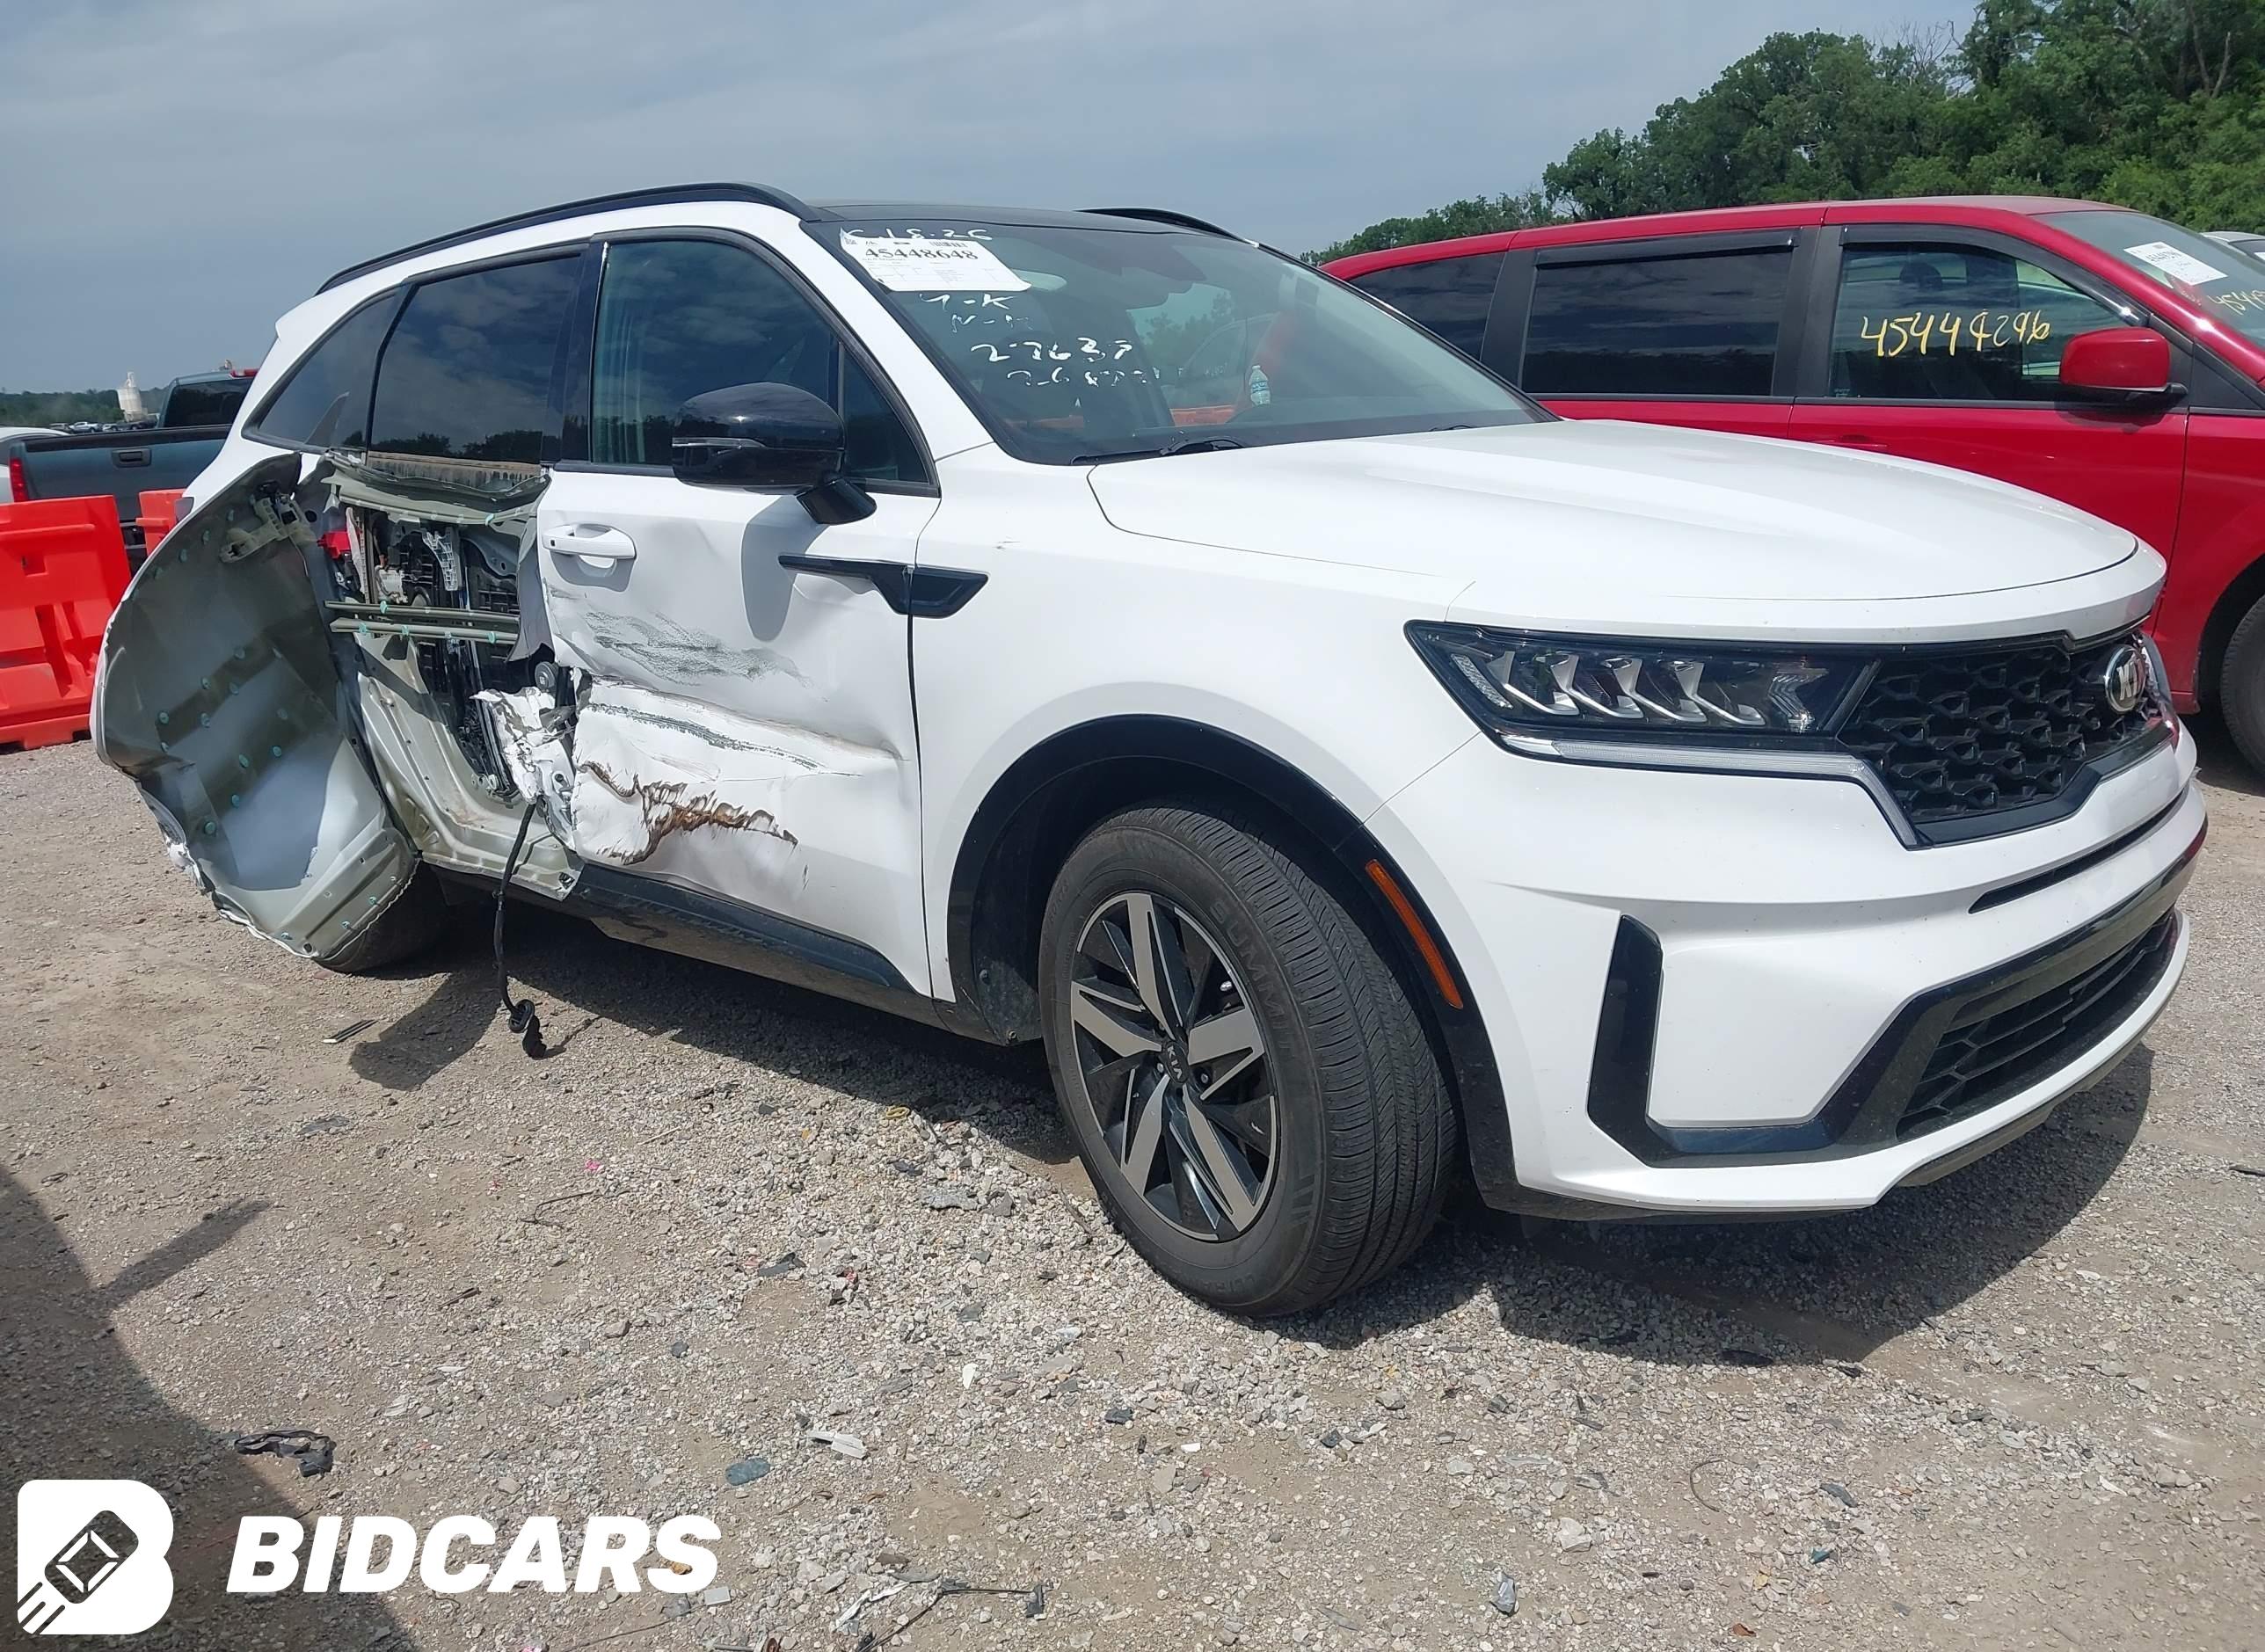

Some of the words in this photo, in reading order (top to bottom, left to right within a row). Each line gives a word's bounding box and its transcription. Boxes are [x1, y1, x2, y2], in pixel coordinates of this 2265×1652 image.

[865, 248, 979, 260] 45448648
[1209, 900, 1299, 1057] SUMMIT
[1167, 1045, 1183, 1080] KIA
